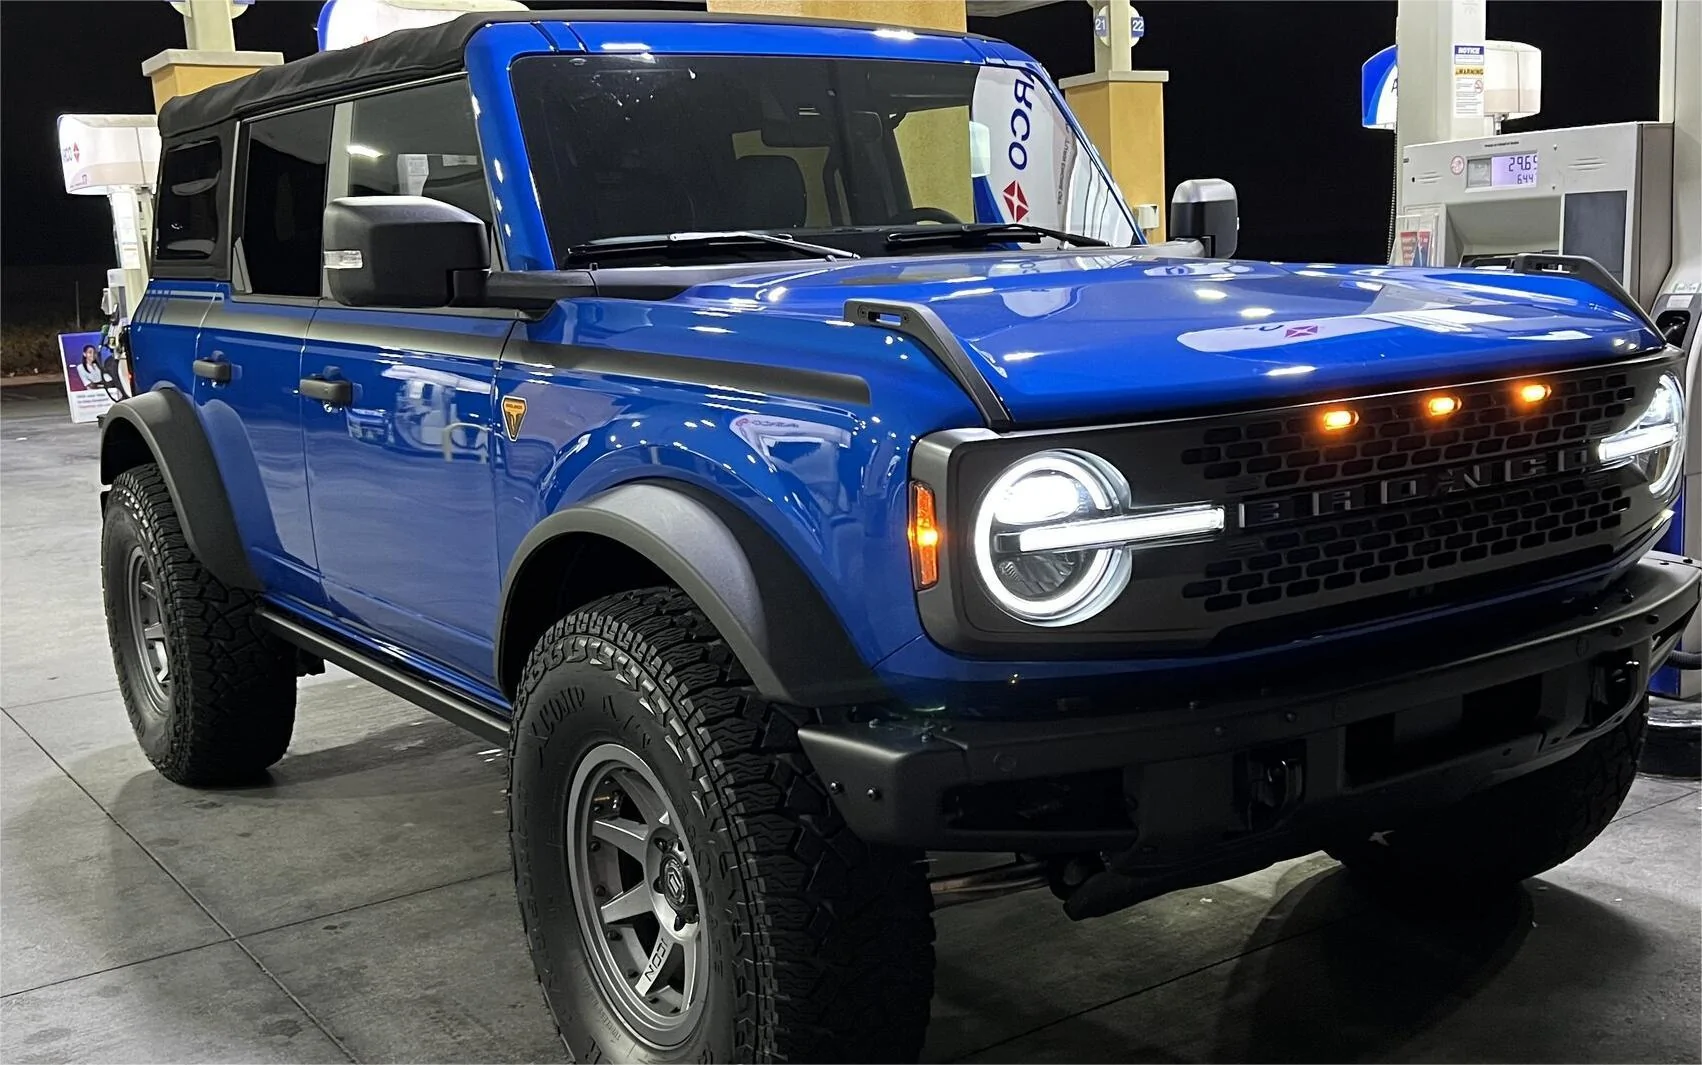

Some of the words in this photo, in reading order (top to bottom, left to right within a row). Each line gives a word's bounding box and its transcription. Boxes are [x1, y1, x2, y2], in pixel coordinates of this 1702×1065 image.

[1095, 18, 1106, 31] 21
[1132, 19, 1144, 32] 22
[1238, 449, 1588, 529] BRONCO
[645, 937, 668, 982] ICON
